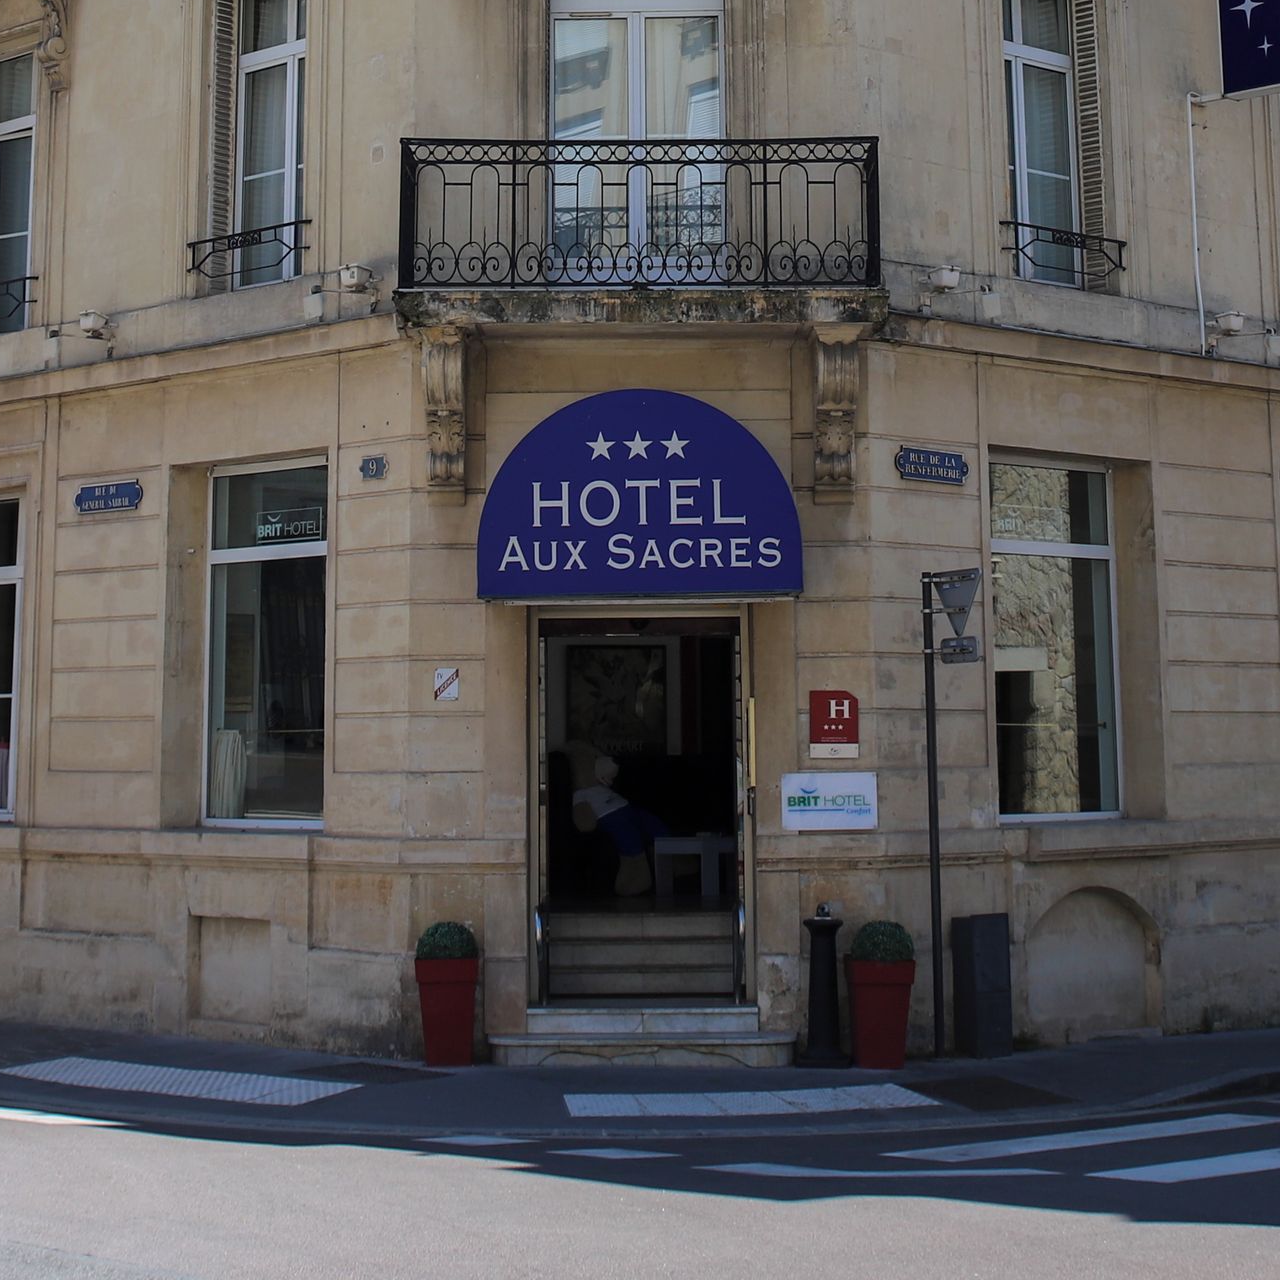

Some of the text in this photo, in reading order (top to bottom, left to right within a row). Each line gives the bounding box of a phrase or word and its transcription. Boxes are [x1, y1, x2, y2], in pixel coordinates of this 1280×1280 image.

[369, 459, 377, 476] 9
[909, 452, 956, 467] RUE DE LA
[905, 464, 961, 479] RENFERMERIE
[532, 477, 746, 527] HOTEL
[258, 521, 320, 538] BRIT HOTEL
[498, 533, 782, 571] AUX SACRES
[437, 671, 458, 696] LICENCE
[828, 699, 852, 719] H
[787, 795, 871, 807] BRIT HOTEL
